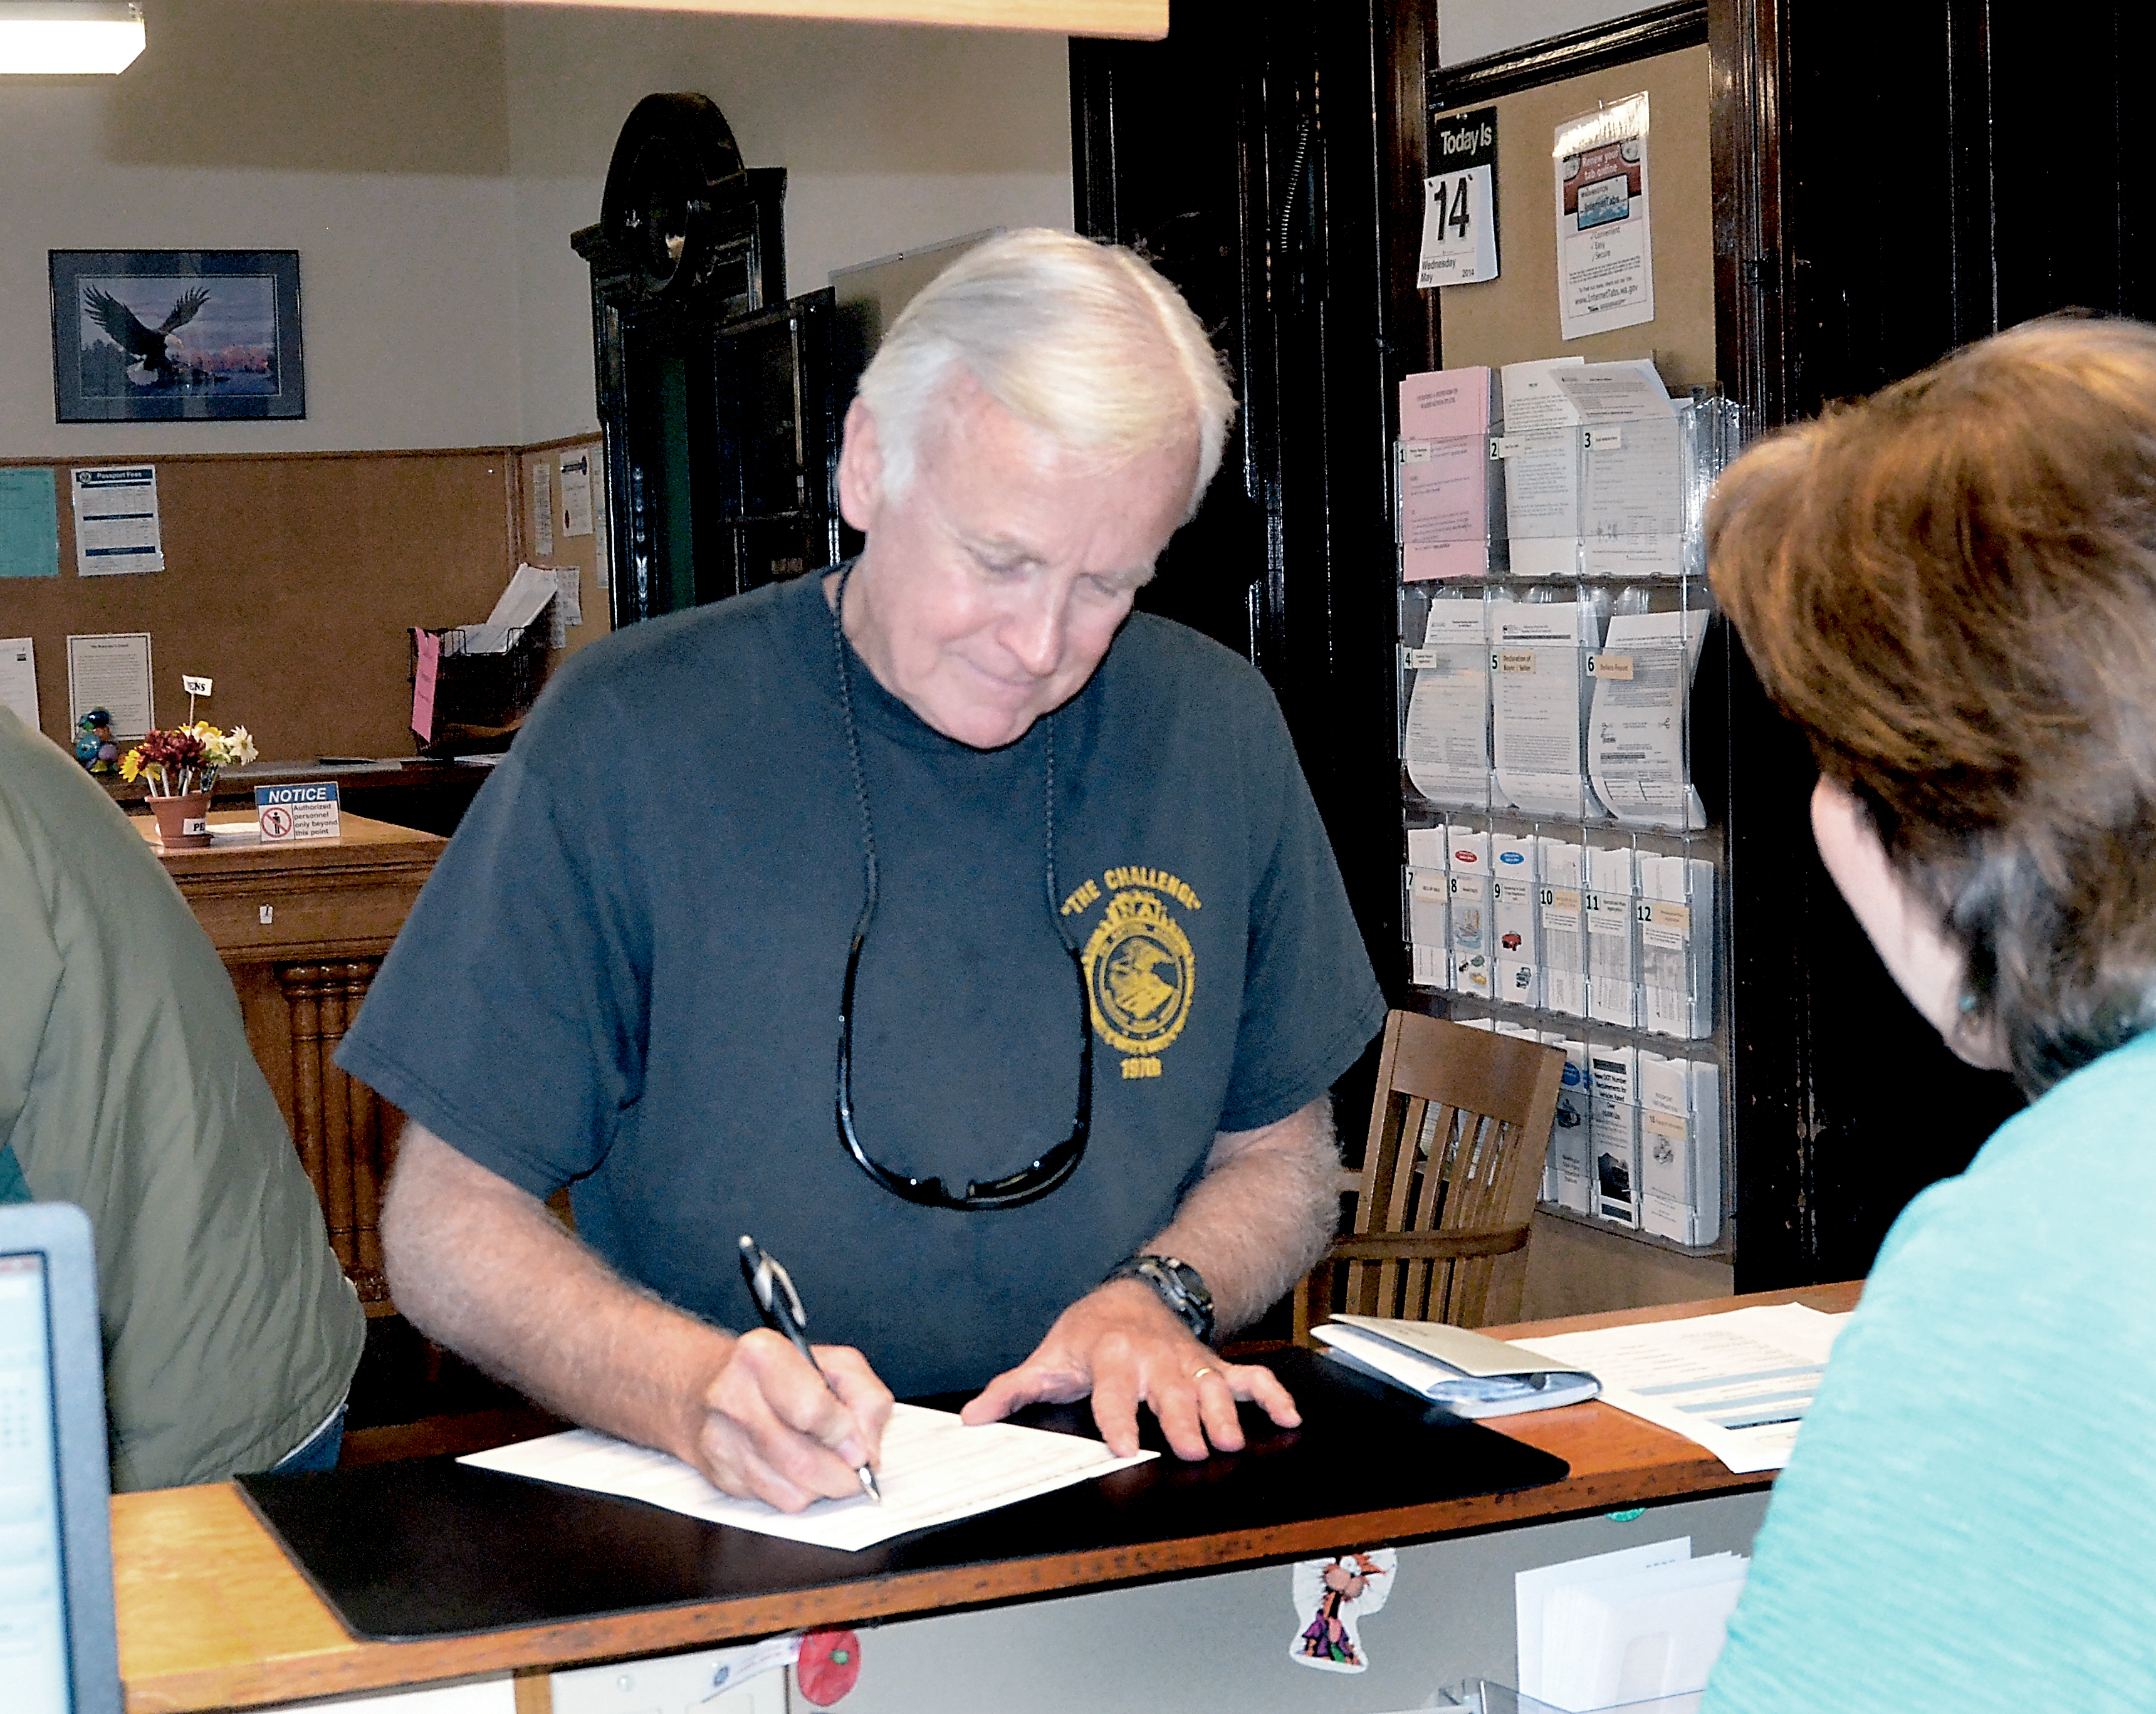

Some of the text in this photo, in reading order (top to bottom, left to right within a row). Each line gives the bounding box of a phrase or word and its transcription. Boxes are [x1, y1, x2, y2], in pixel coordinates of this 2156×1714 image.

[1441, 122, 1492, 155] Today Is
[1434, 177, 1470, 240] 14
[1422, 258, 1455, 269] Wednesday
[1420, 273, 1433, 283] May
[1462, 269, 1475, 278] 2014
[1585, 432, 1591, 447] 3
[1400, 449, 1405, 462] 1
[1492, 442, 1497, 457] 2
[97, 472, 125, 480] Passport
[1405, 652, 1411, 666] 4
[1492, 655, 1498, 669] 5
[1588, 656, 1594, 672] 6
[269, 788, 326, 803] NOTICE
[295, 812, 329, 820] personnel
[193, 823, 206, 832] PE
[1408, 872, 1413, 885] 7
[1451, 879, 1457, 892] 8
[1494, 884, 1500, 898] 9
[1541, 890, 1552, 905] 10
[1586, 894, 1599, 910] 11
[1638, 906, 1651, 922] 12
[1612, 1075, 1626, 1084] Number
